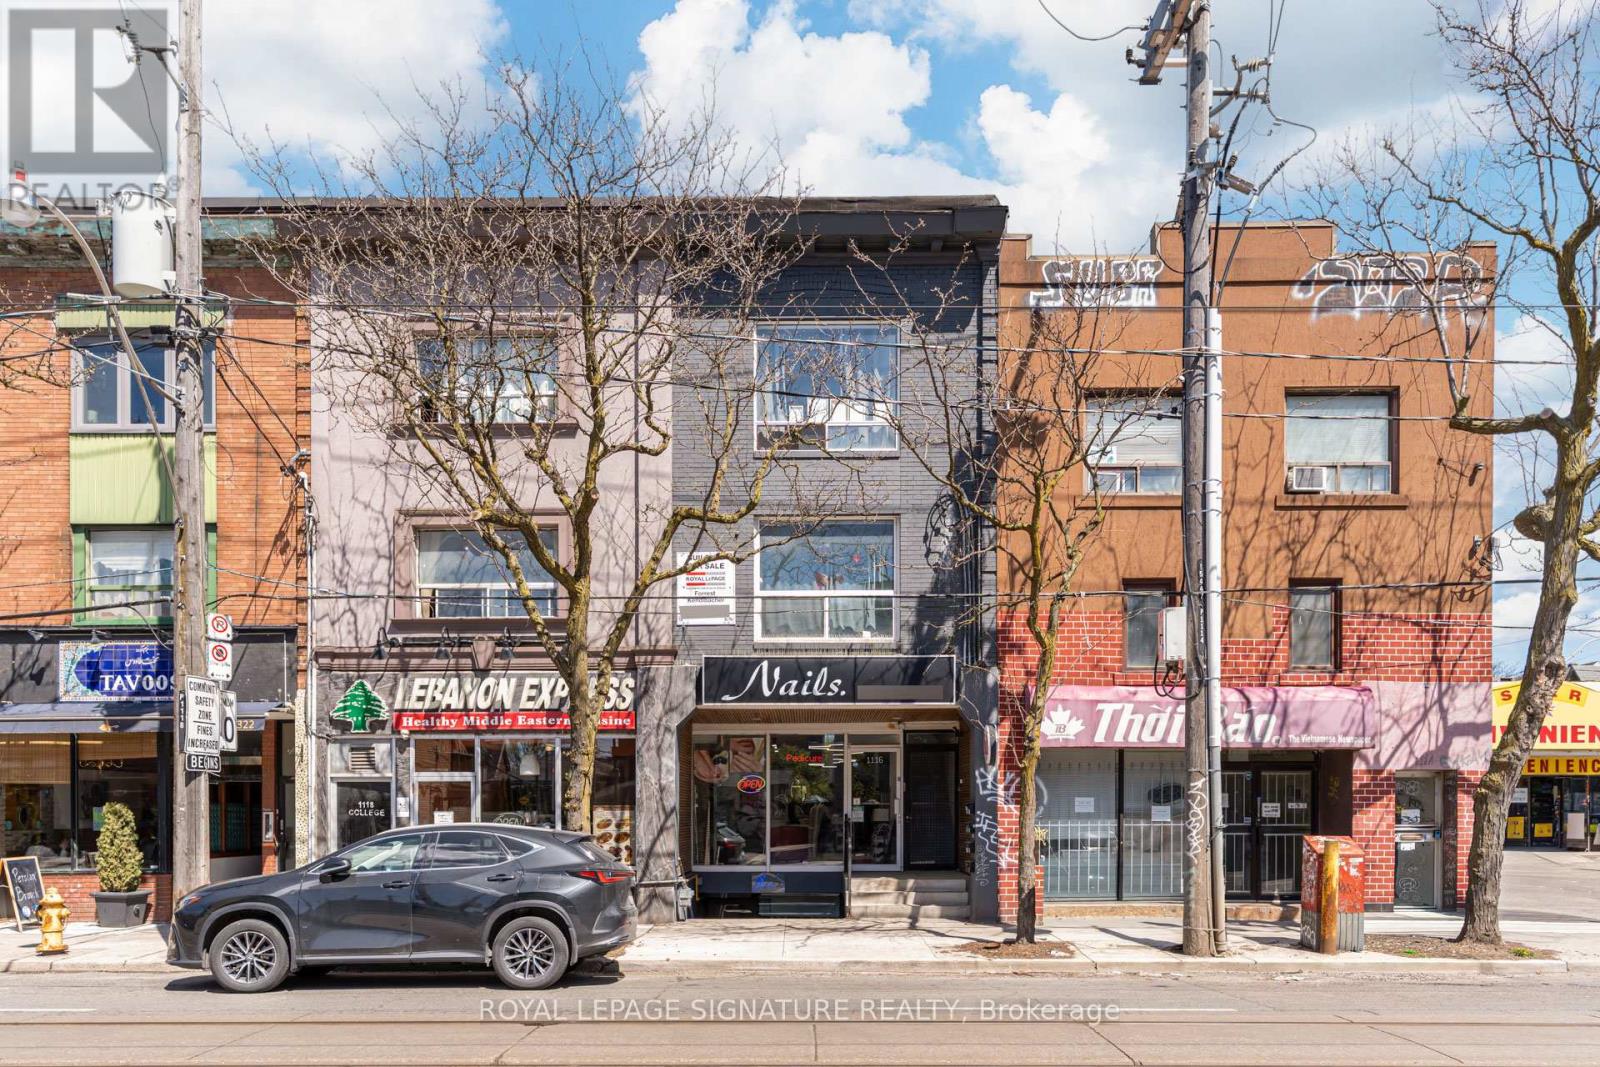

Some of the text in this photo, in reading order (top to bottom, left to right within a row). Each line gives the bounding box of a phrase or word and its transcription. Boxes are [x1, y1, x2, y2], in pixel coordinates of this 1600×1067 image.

[188, 680, 218, 695] COMMUNITY
[393, 677, 635, 710] LEBANON EXPSS
[1500, 688, 1582, 702] SR
[194, 695, 215, 708] SAFETY
[198, 710, 212, 721] ZONE
[402, 715, 631, 728] Healthy Middle Eastern sine
[196, 725, 213, 736] FINES
[224, 716, 235, 743] 0
[187, 738, 218, 750] INCREASED
[1288, 735, 1300, 744] The
[1301, 735, 1336, 744] Vietnamese
[190, 755, 219, 769] BEGINS
[785, 753, 824, 763] Pedicure
[866, 756, 884, 764] 1116
[740, 779, 762, 790] OPEN
